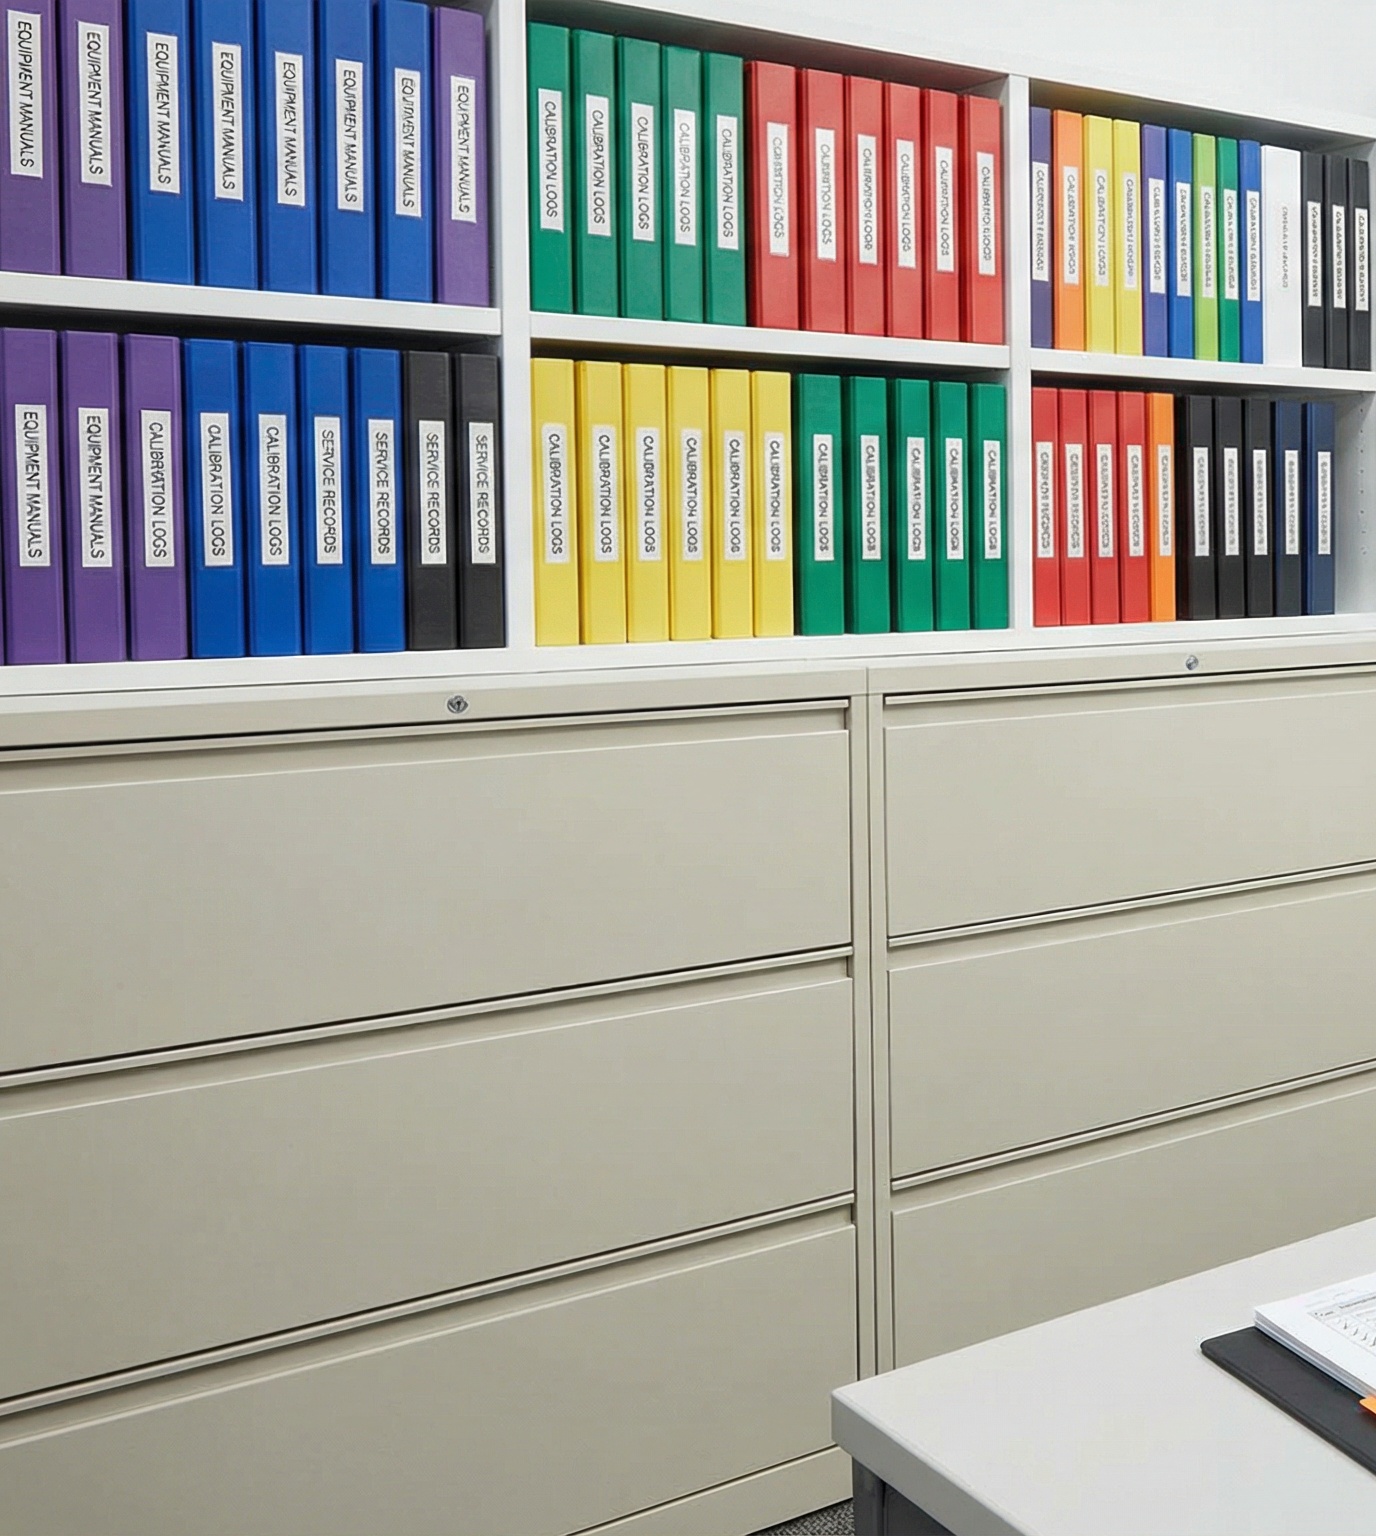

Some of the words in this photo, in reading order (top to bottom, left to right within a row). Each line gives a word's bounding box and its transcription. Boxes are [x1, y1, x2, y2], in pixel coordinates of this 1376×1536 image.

[20, 102, 34, 167] MANUALS
[24, 412, 40, 490] EQUIPMENT
[208, 425, 223, 514] CALIBRATION
[267, 427, 280, 515] CALIBRATION
[376, 432, 388, 487] SERVICE
[427, 433, 439, 488] SERVICE
[27, 494, 42, 558] MANUALS
[90, 495, 104, 558] MANUALS
[152, 521, 166, 557] LOGS
[211, 520, 225, 556] LOGS
[269, 520, 282, 555] LOGS
[377, 492, 390, 554] RECORDS
[428, 492, 440, 553] RECORDS
